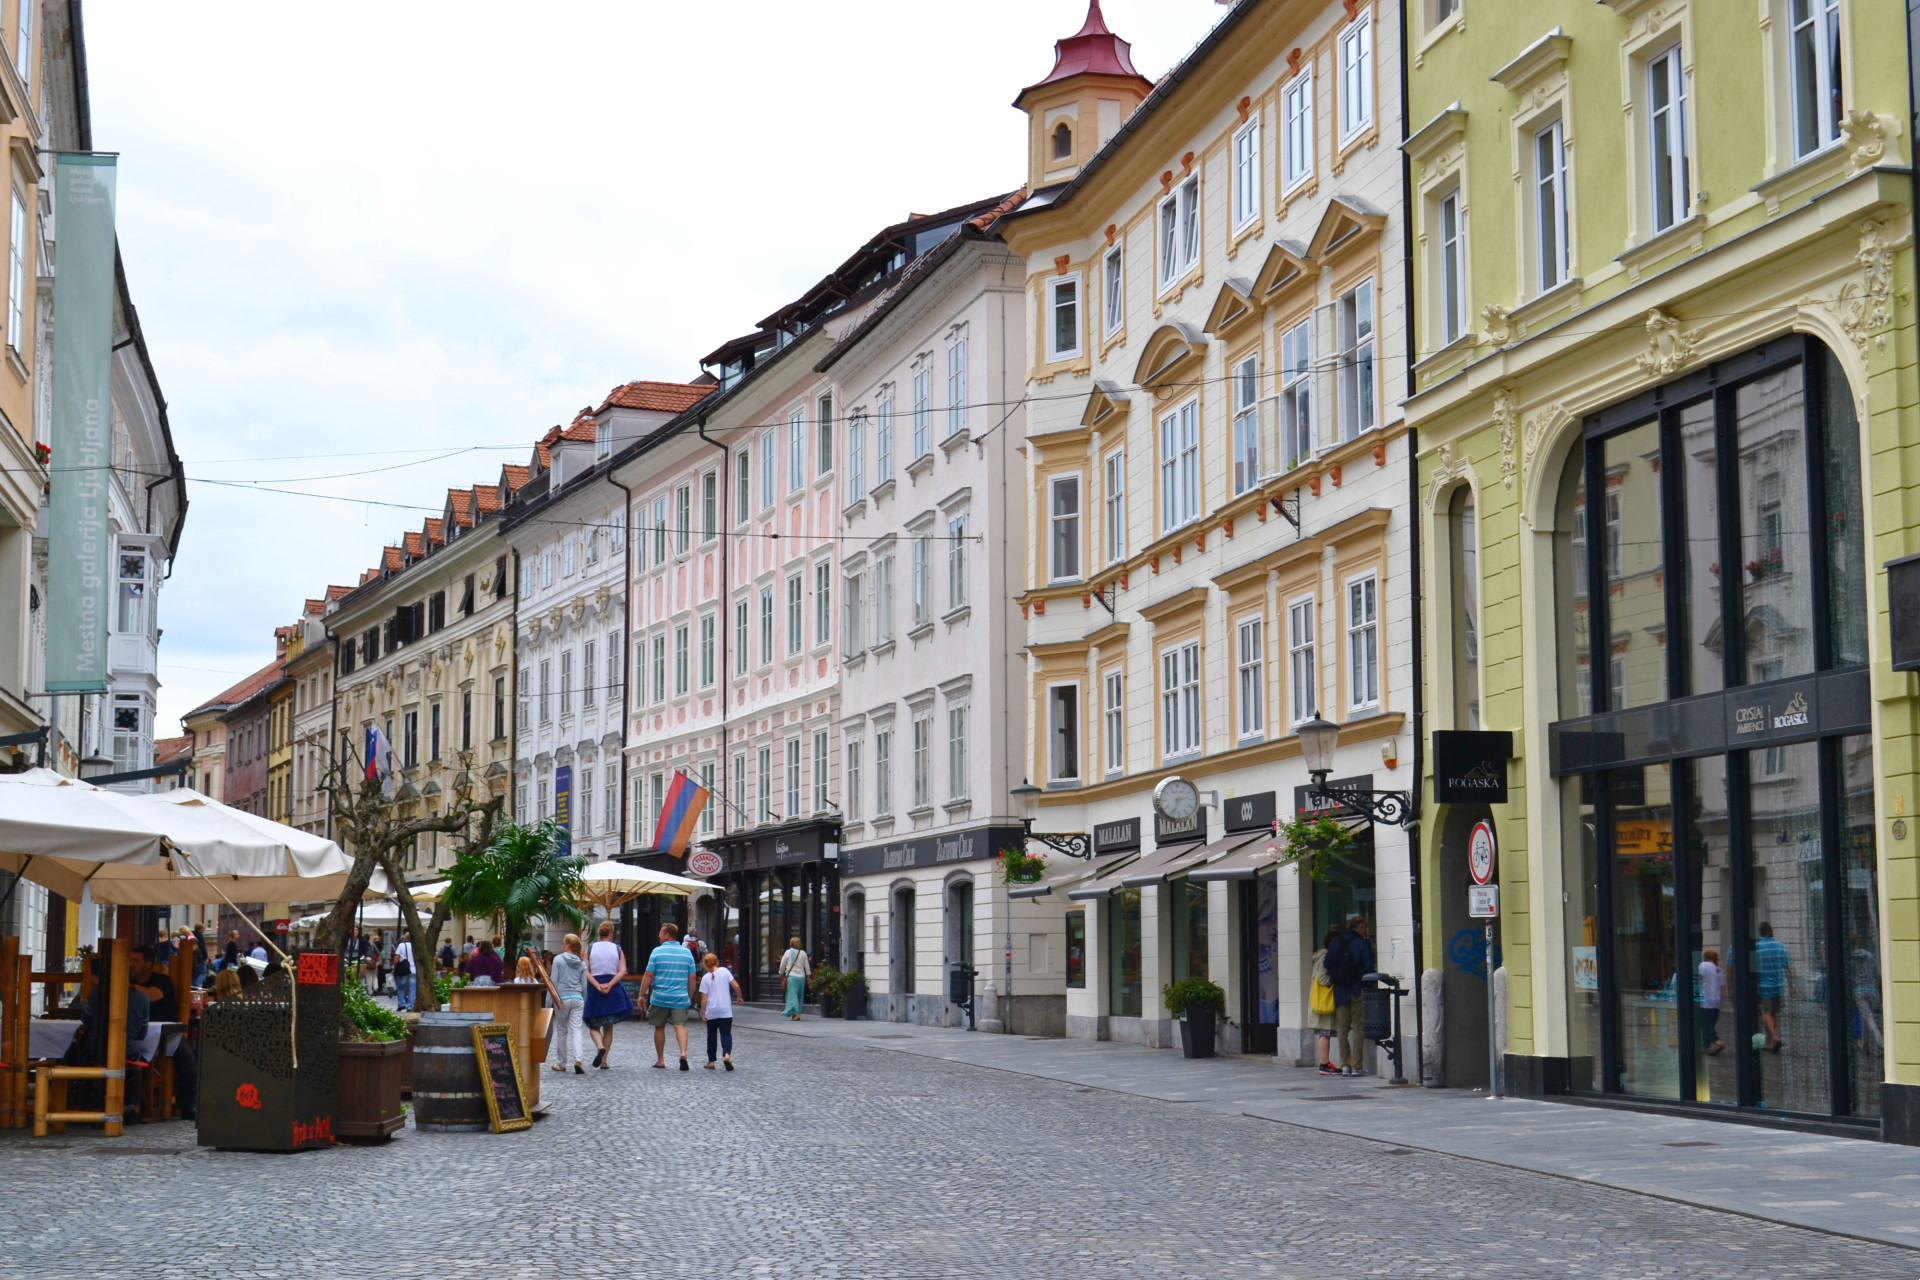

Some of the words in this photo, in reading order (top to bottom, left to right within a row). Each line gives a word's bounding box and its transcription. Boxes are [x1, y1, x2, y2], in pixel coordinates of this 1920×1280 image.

[79, 398, 102, 499] Ljubljana
[78, 506, 101, 588] galerija
[77, 595, 95, 672] Mestna
[1736, 706, 1764, 722] CRYSTAL
[1098, 824, 1132, 846] MALALAN
